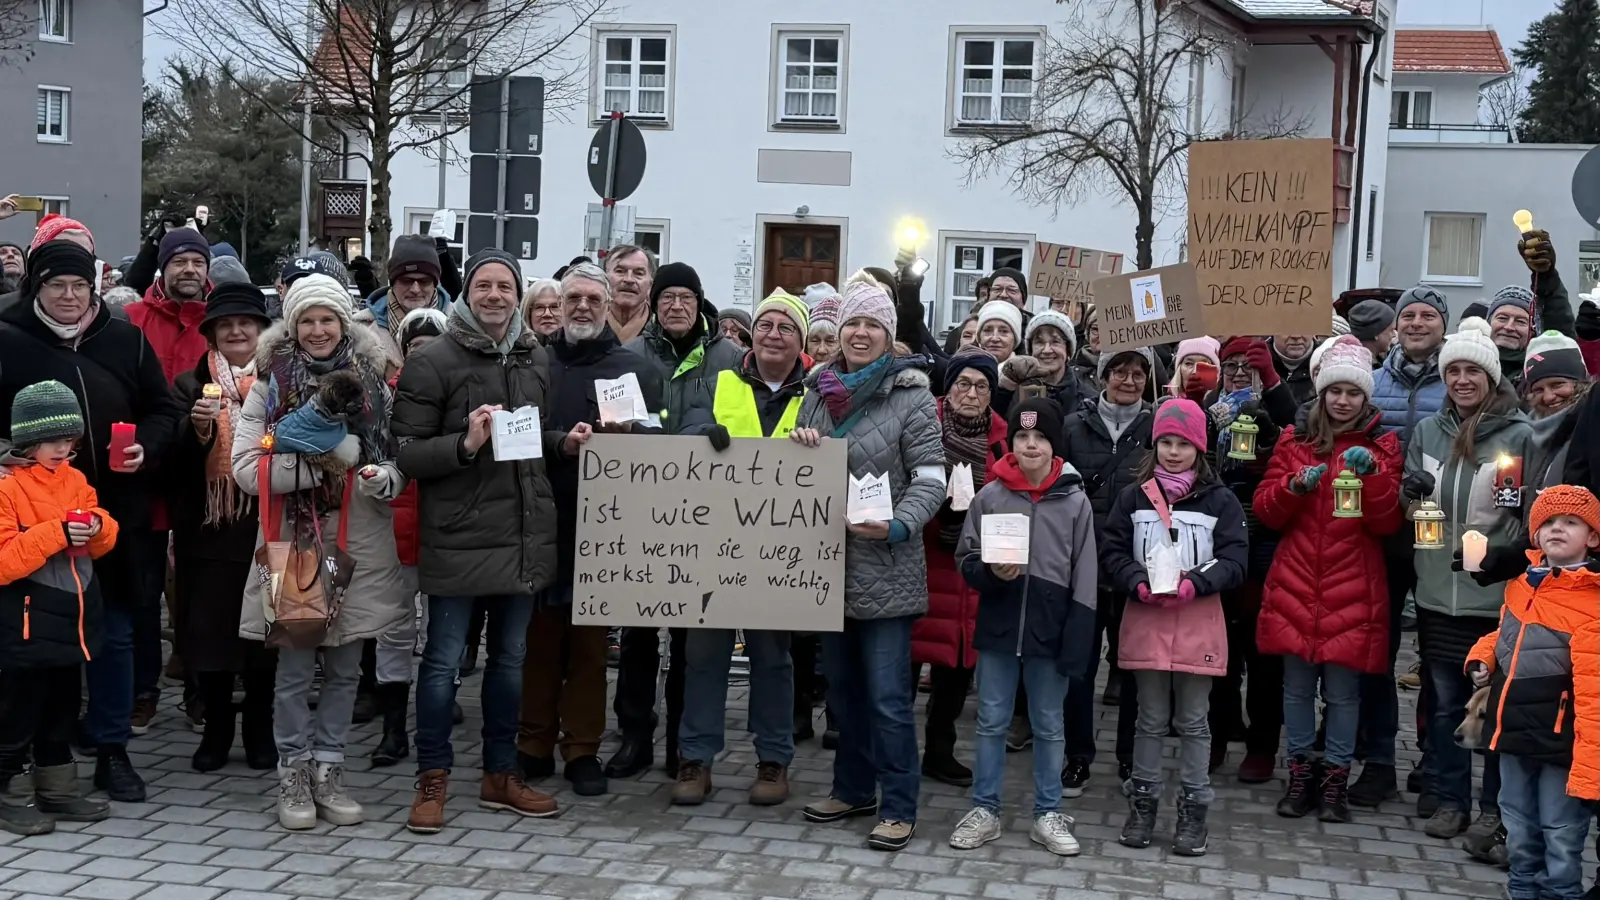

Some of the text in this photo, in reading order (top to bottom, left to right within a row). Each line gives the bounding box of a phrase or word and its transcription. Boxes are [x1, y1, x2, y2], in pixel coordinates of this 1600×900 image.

[1201, 171, 1307, 203] !!! KEIN !!!
[1193, 209, 1330, 244] WAHLKAMPF
[1195, 248, 1229, 269] AUF
[1229, 248, 1265, 270] DEM
[1035, 272, 1094, 297] EINFAL
[1203, 283, 1314, 306] DER OPFER
[1105, 304, 1132, 322] MEIN
[1168, 302, 1183, 313] DIE
[1109, 317, 1188, 345] DEMOKRATIE
[582, 450, 815, 487] Demokratie
[583, 495, 832, 528] ist wie WLAN
[579, 534, 843, 570] erst wenn sie weg ist
[579, 563, 831, 606] merkst Du, wie wichtig
[578, 595, 611, 616] sie
[637, 600, 687, 617] war
